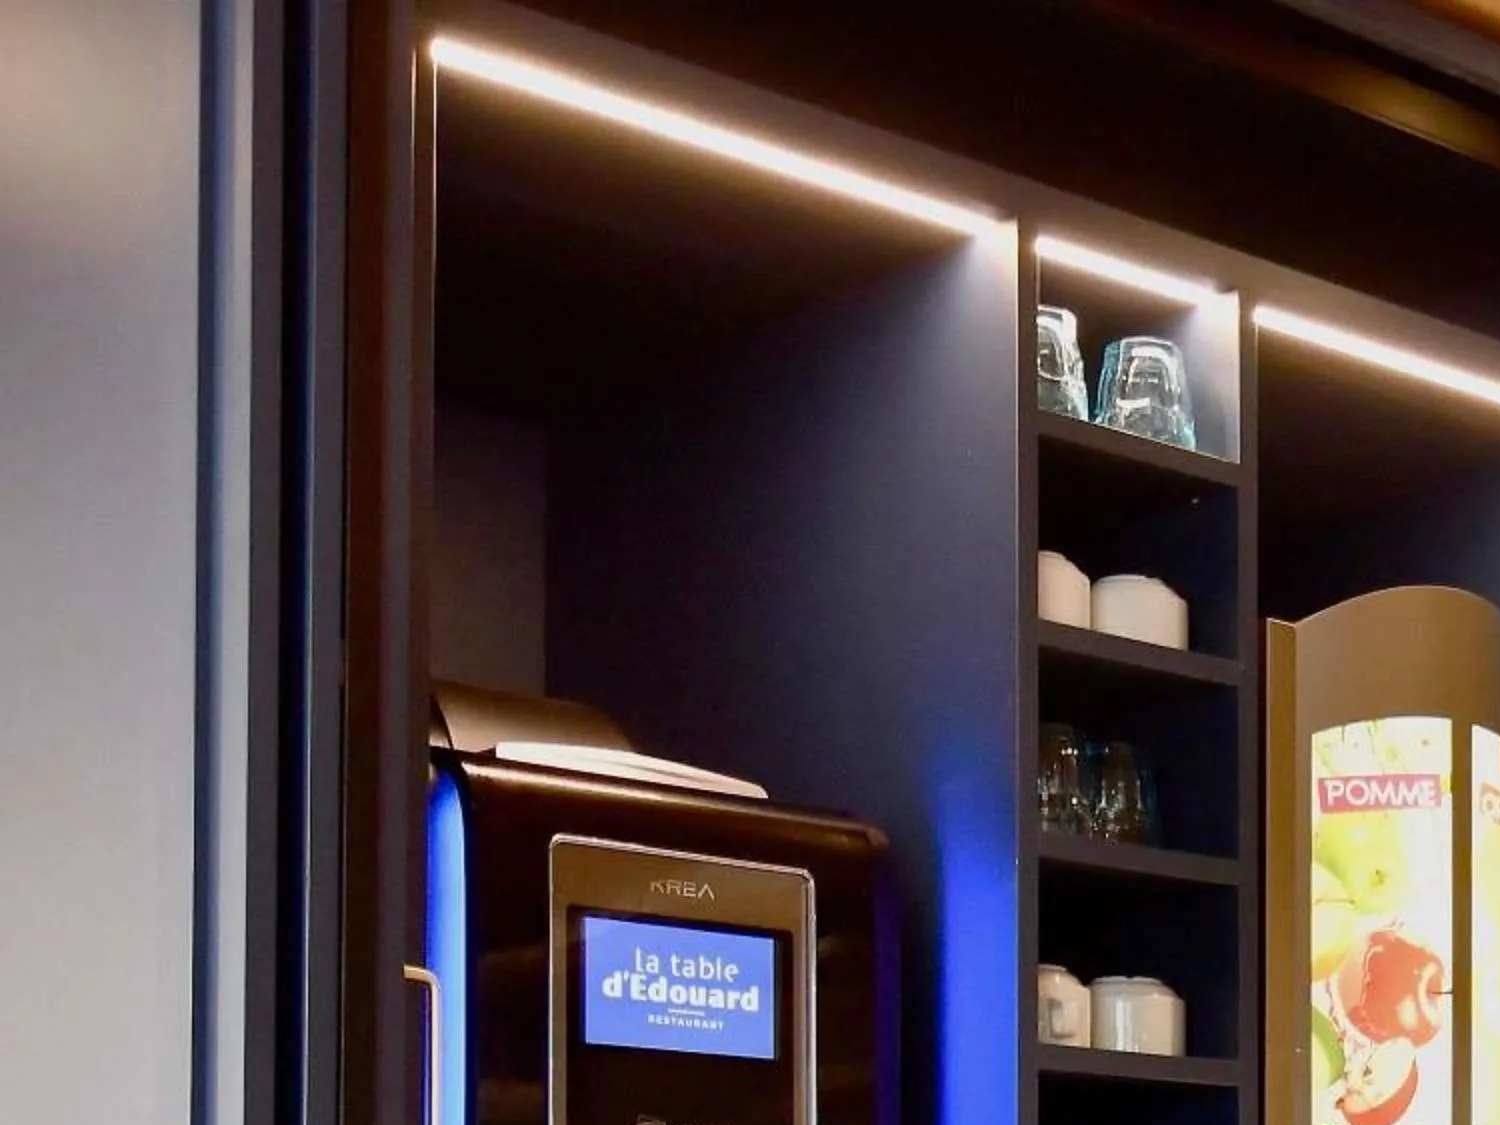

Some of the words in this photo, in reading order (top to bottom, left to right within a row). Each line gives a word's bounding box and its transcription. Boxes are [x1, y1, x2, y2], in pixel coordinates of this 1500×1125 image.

[1324, 779, 1437, 807] POMME
[651, 879, 715, 900] KREA
[635, 947, 659, 974] la
[670, 954, 739, 983] table
[648, 1014, 724, 1031] RESTAURANT
